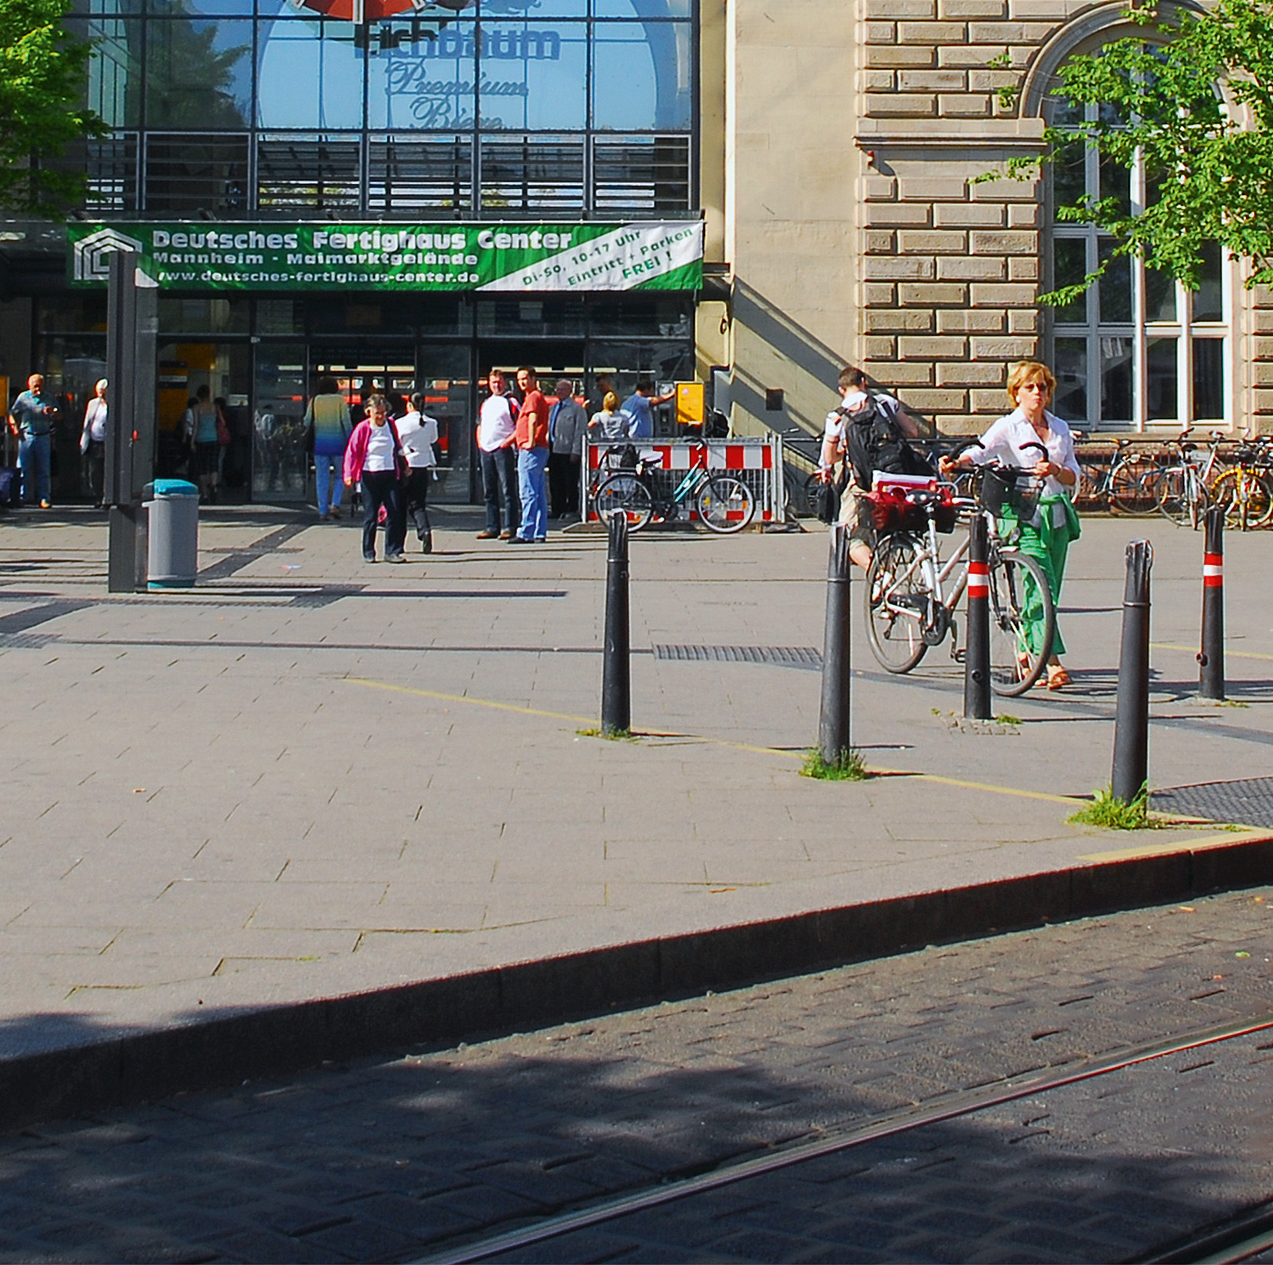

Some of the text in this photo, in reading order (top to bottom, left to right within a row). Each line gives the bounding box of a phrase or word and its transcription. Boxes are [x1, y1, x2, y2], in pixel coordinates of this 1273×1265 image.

[385, 59, 529, 95] Premium
[153, 230, 572, 252] Deutsches Fertighaus Center
[571, 243, 610, 266] 10-17
[615, 230, 642, 247] Uhr
[153, 252, 263, 264] Mannheim
[287, 252, 478, 266] Maimarktgelände
[568, 257, 623, 286] Eintritt
[640, 228, 693, 255] Parken
[623, 257, 661, 279] FREI
